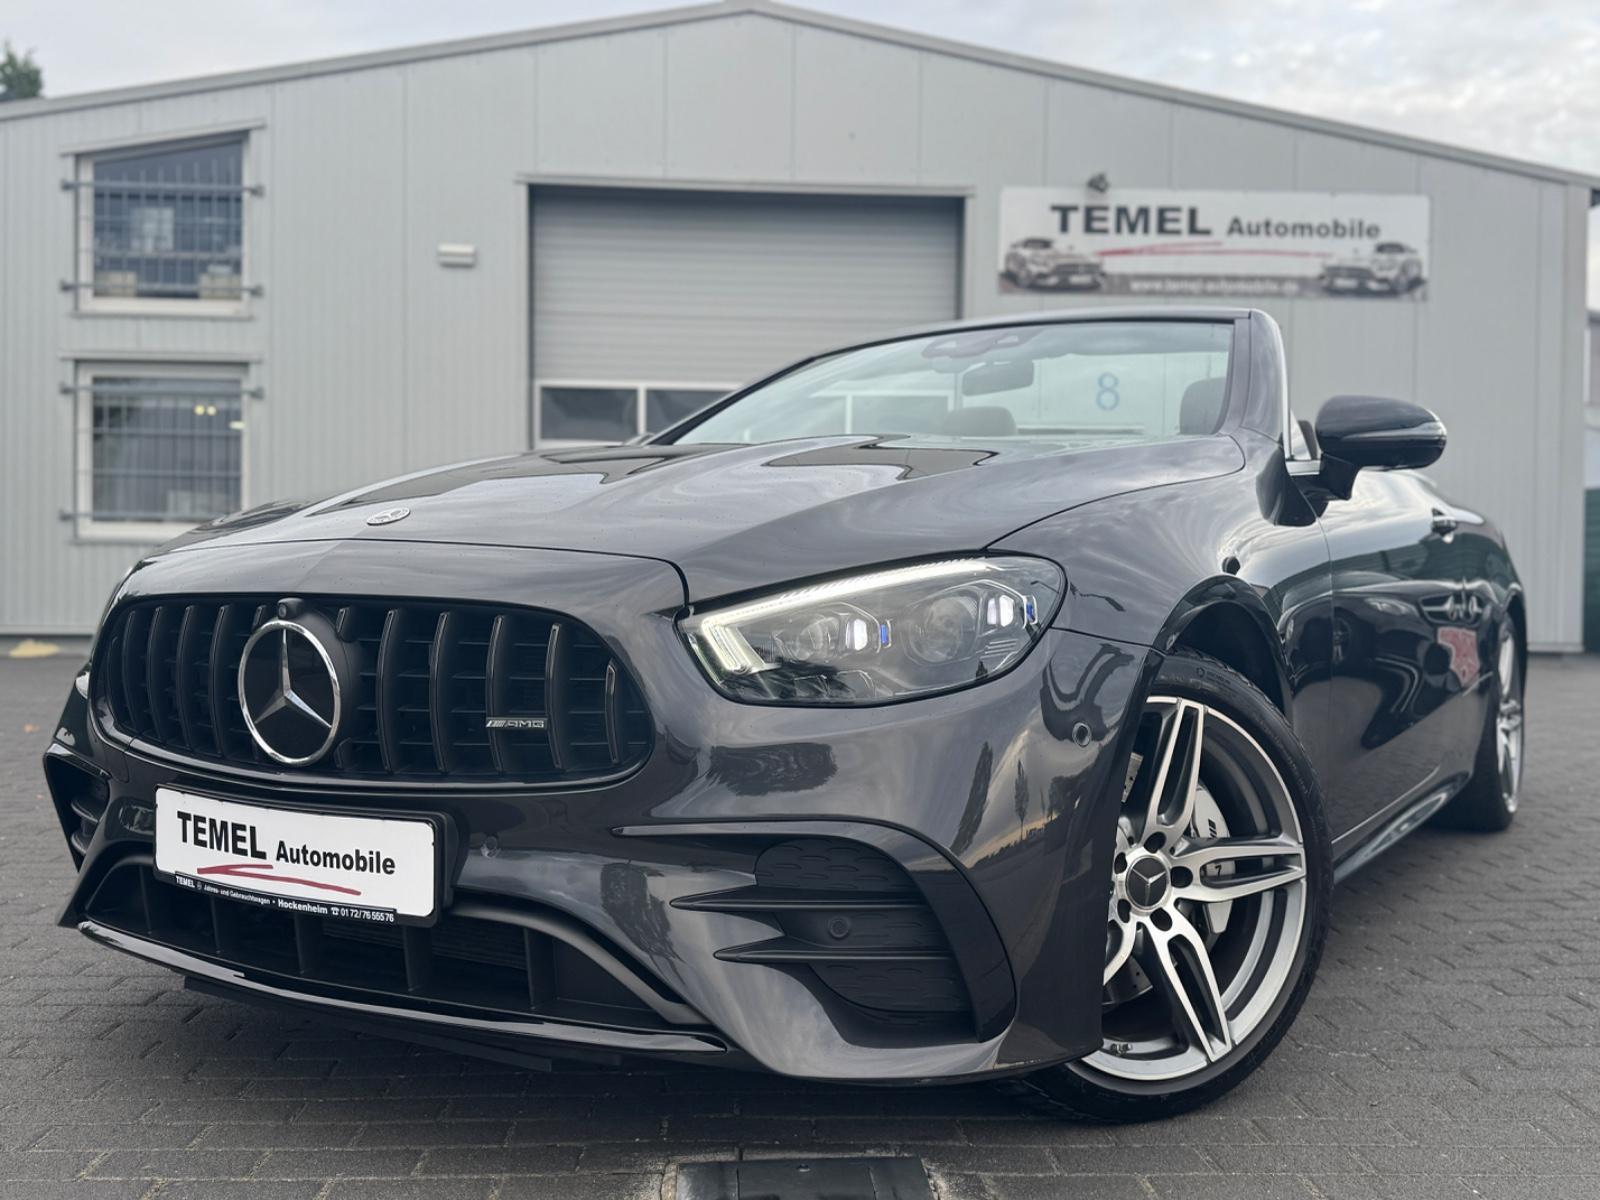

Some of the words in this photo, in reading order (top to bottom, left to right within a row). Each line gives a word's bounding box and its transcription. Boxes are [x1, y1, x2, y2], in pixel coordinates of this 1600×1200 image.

[1050, 205, 1212, 237] TEMEL
[1227, 217, 1381, 239] Automobile
[1096, 372, 1120, 411] 8
[177, 811, 267, 860] TEMEL
[276, 840, 396, 875] Automobile
[175, 875, 196, 888] TEMEL
[278, 899, 328, 914] Hockenheim
